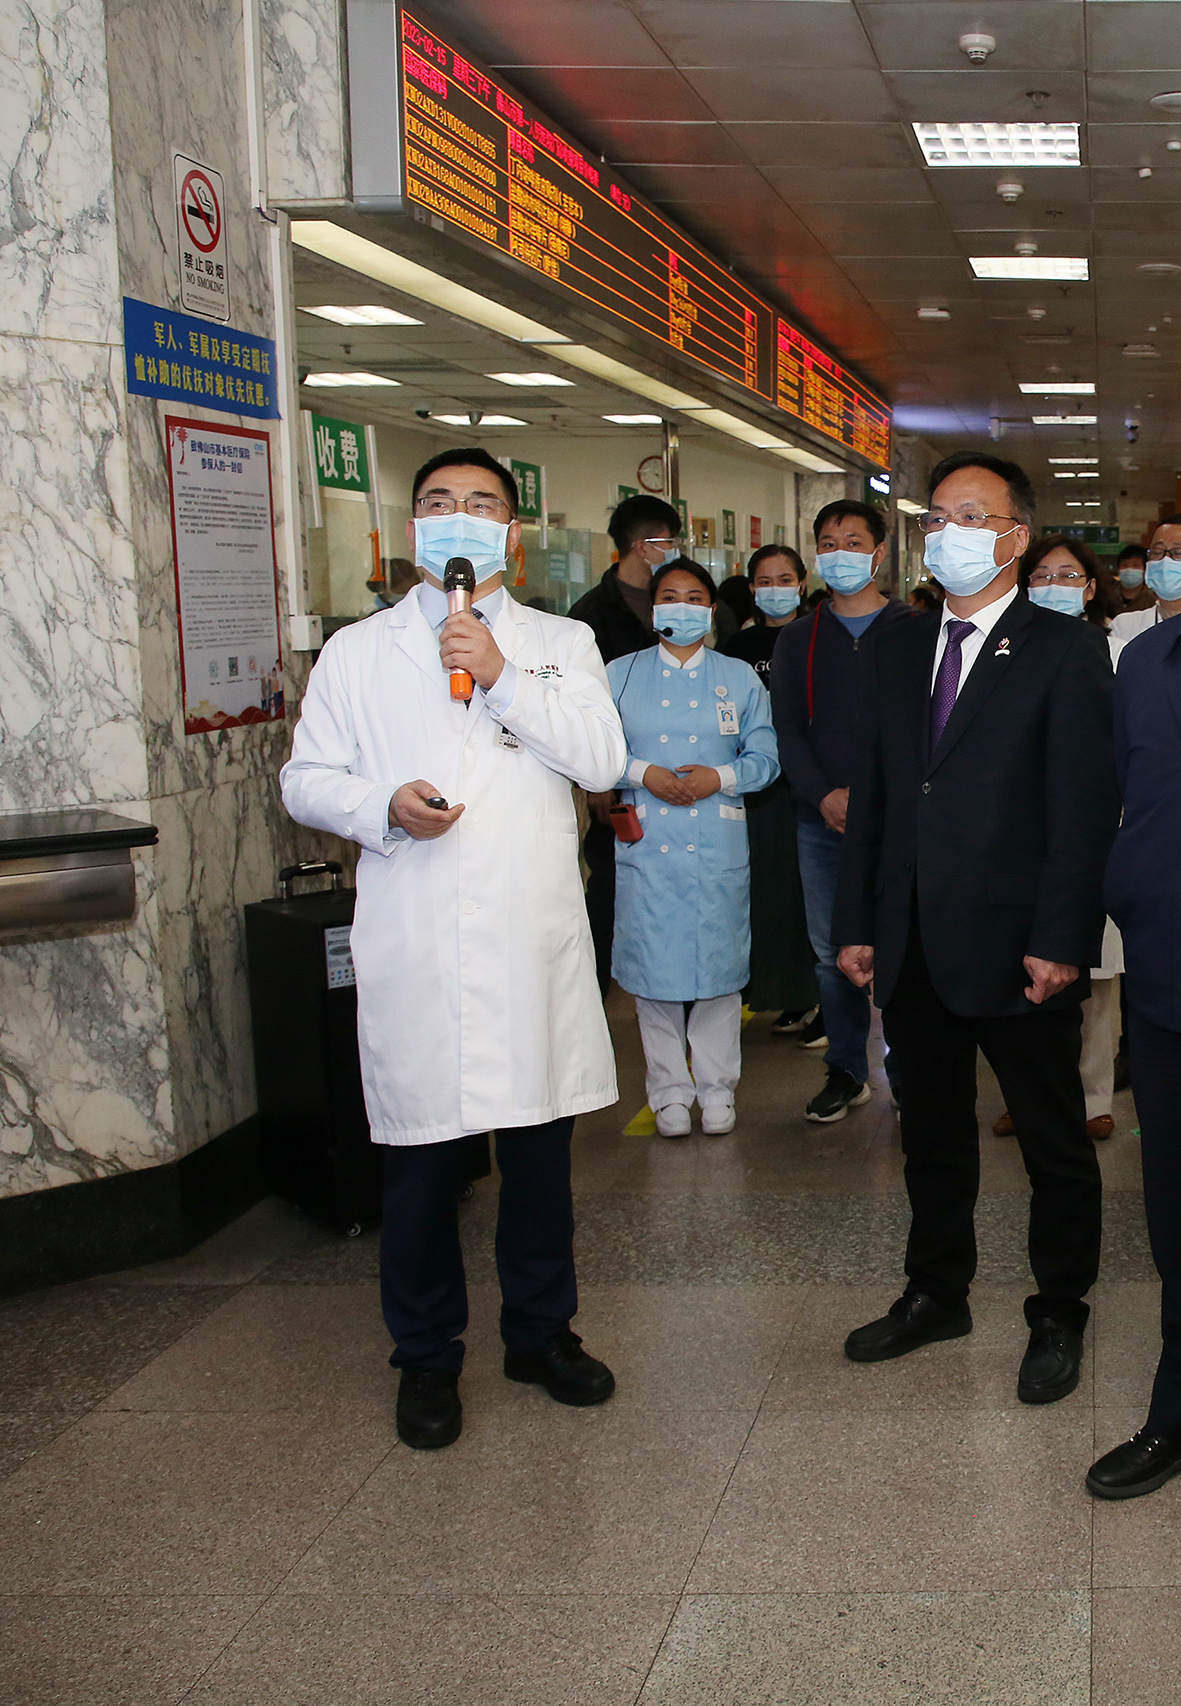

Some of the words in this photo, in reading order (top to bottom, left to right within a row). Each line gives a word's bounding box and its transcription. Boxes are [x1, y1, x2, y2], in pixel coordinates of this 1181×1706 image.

[184, 252, 224, 280] 禁止吸烟
[186, 272, 195, 285] NO
[197, 277, 224, 295] SMOKING
[154, 321, 270, 375] 军人、军属及享受定期抚
[201, 458, 243, 474] 参保人的一封信
[316, 425, 361, 483] 收费
